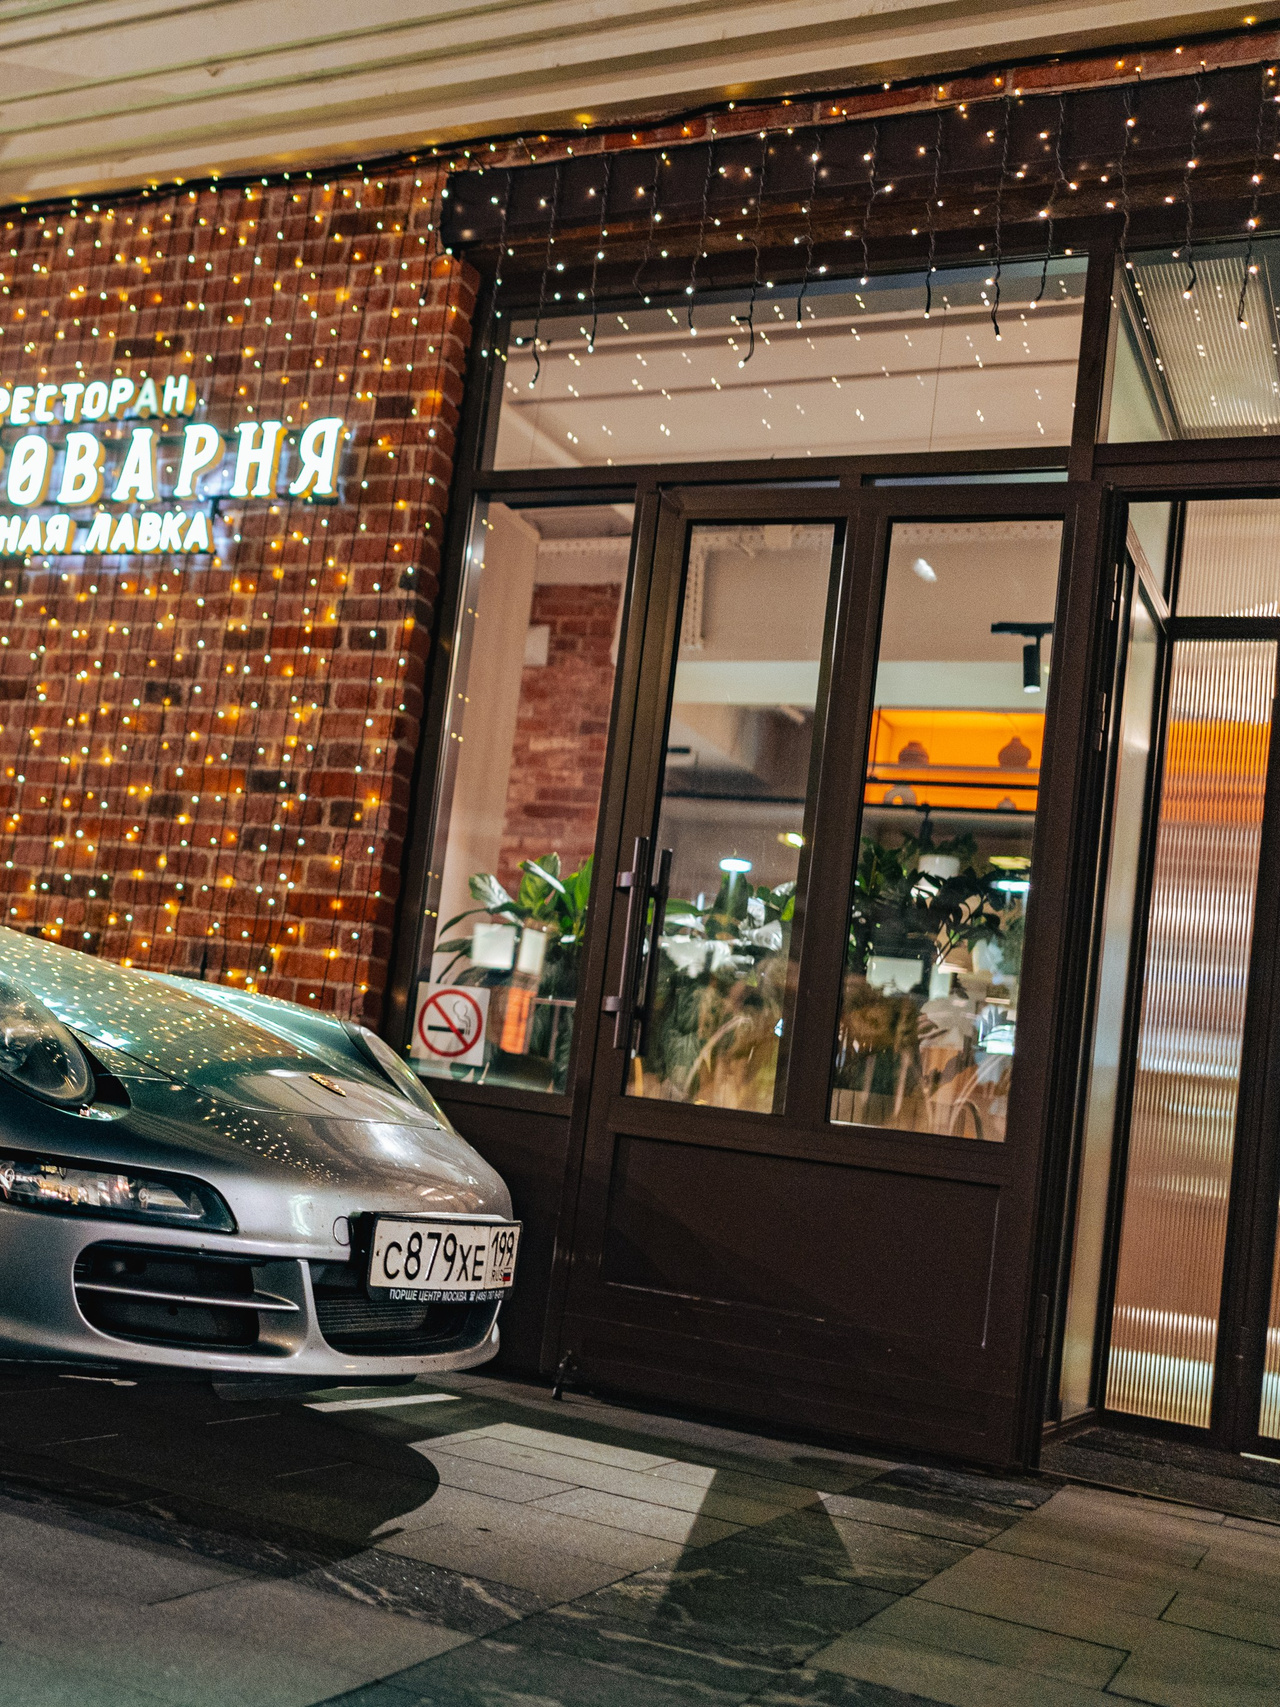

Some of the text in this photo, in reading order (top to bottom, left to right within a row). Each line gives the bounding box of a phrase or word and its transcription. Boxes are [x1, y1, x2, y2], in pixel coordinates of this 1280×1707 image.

[85, 511, 212, 551] ЛАВКА
[491, 1231, 515, 1267] 199
[491, 1269, 504, 1282] RUS
[389, 1288, 418, 1300] ПОРШЕ
[418, 1290, 441, 1302] ЦЕНТР
[442, 1291, 467, 1301] МОСКВА
